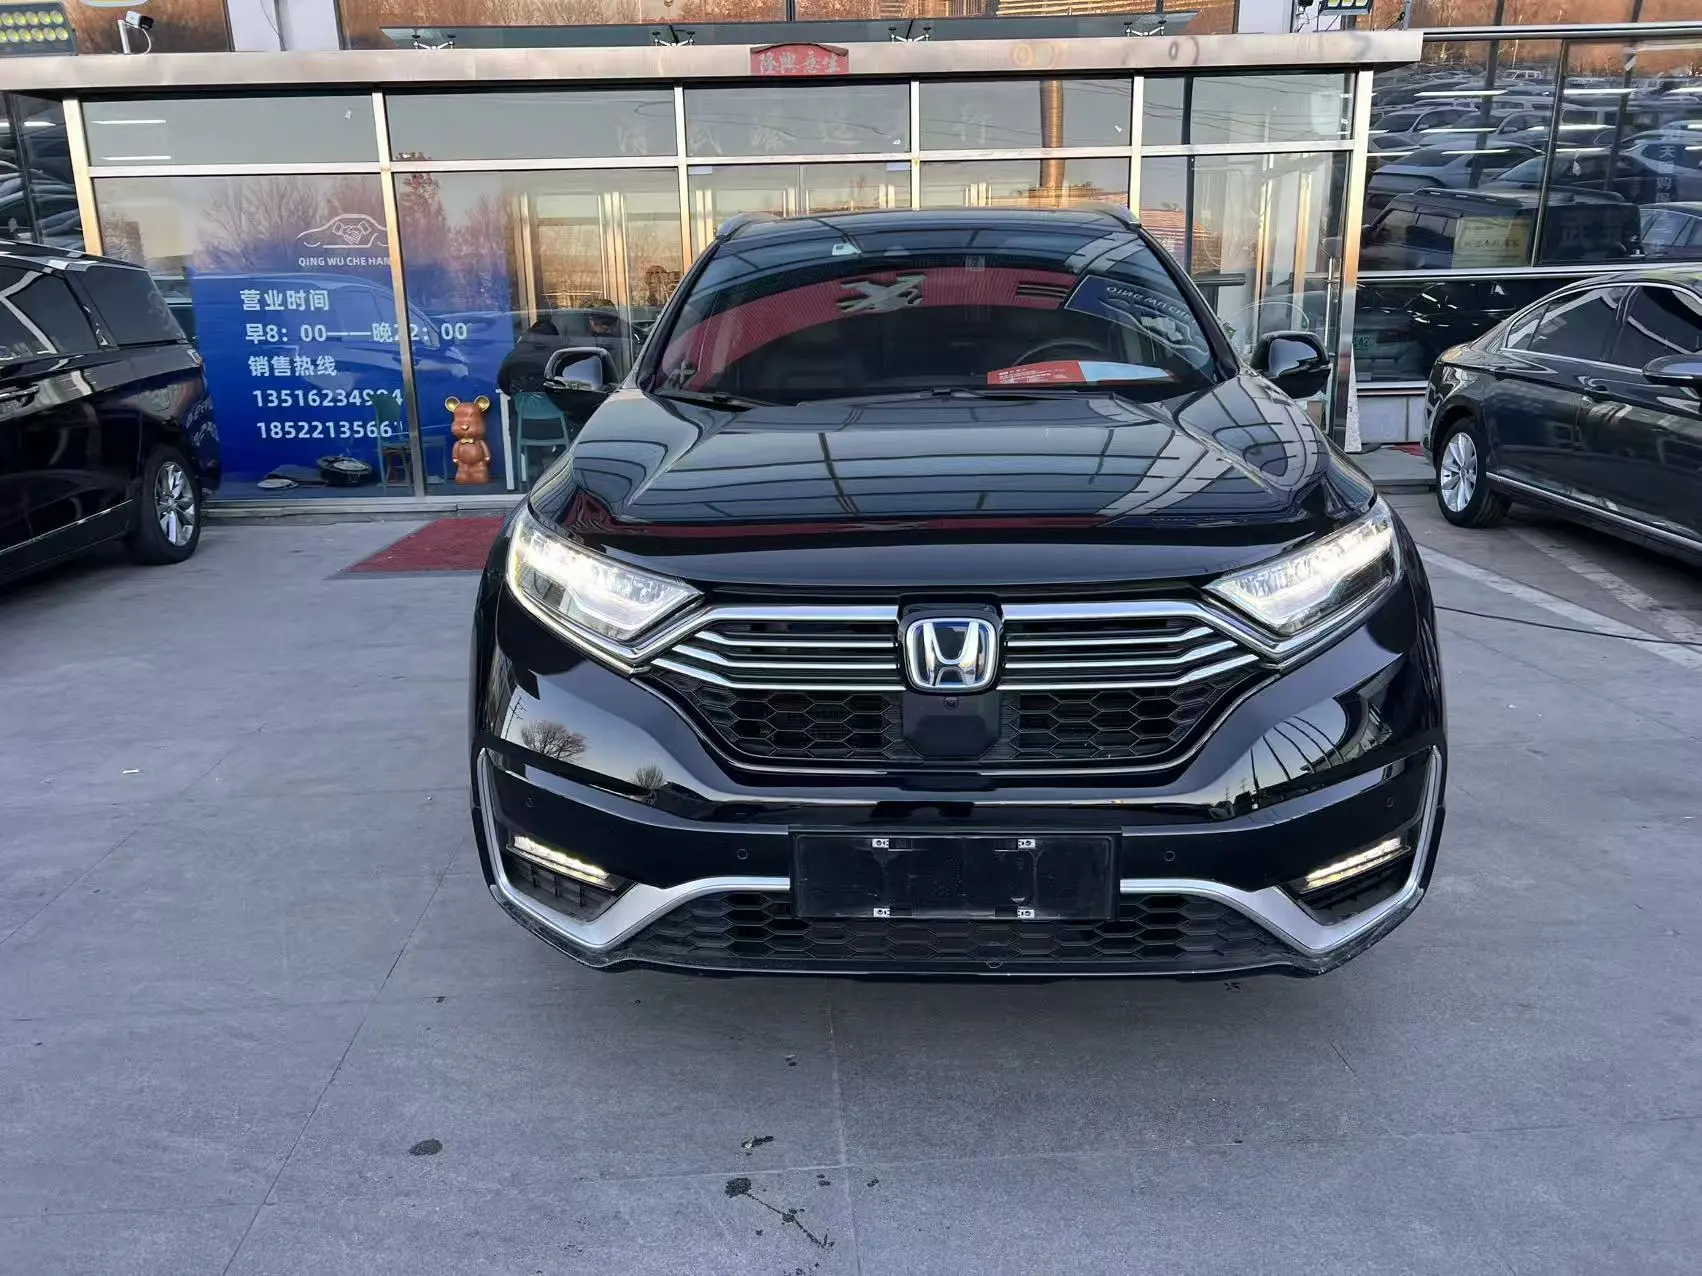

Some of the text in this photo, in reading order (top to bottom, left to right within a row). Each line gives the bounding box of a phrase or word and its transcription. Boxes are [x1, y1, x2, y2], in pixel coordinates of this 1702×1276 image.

[298, 257, 325, 267] QING
[326, 257, 344, 266] WU
[346, 257, 367, 266] CHE
[240, 289, 329, 311] 营业时间
[248, 355, 337, 377] 销售热线
[253, 388, 403, 407] 1351623494
[257, 420, 402, 439] 1852213566
